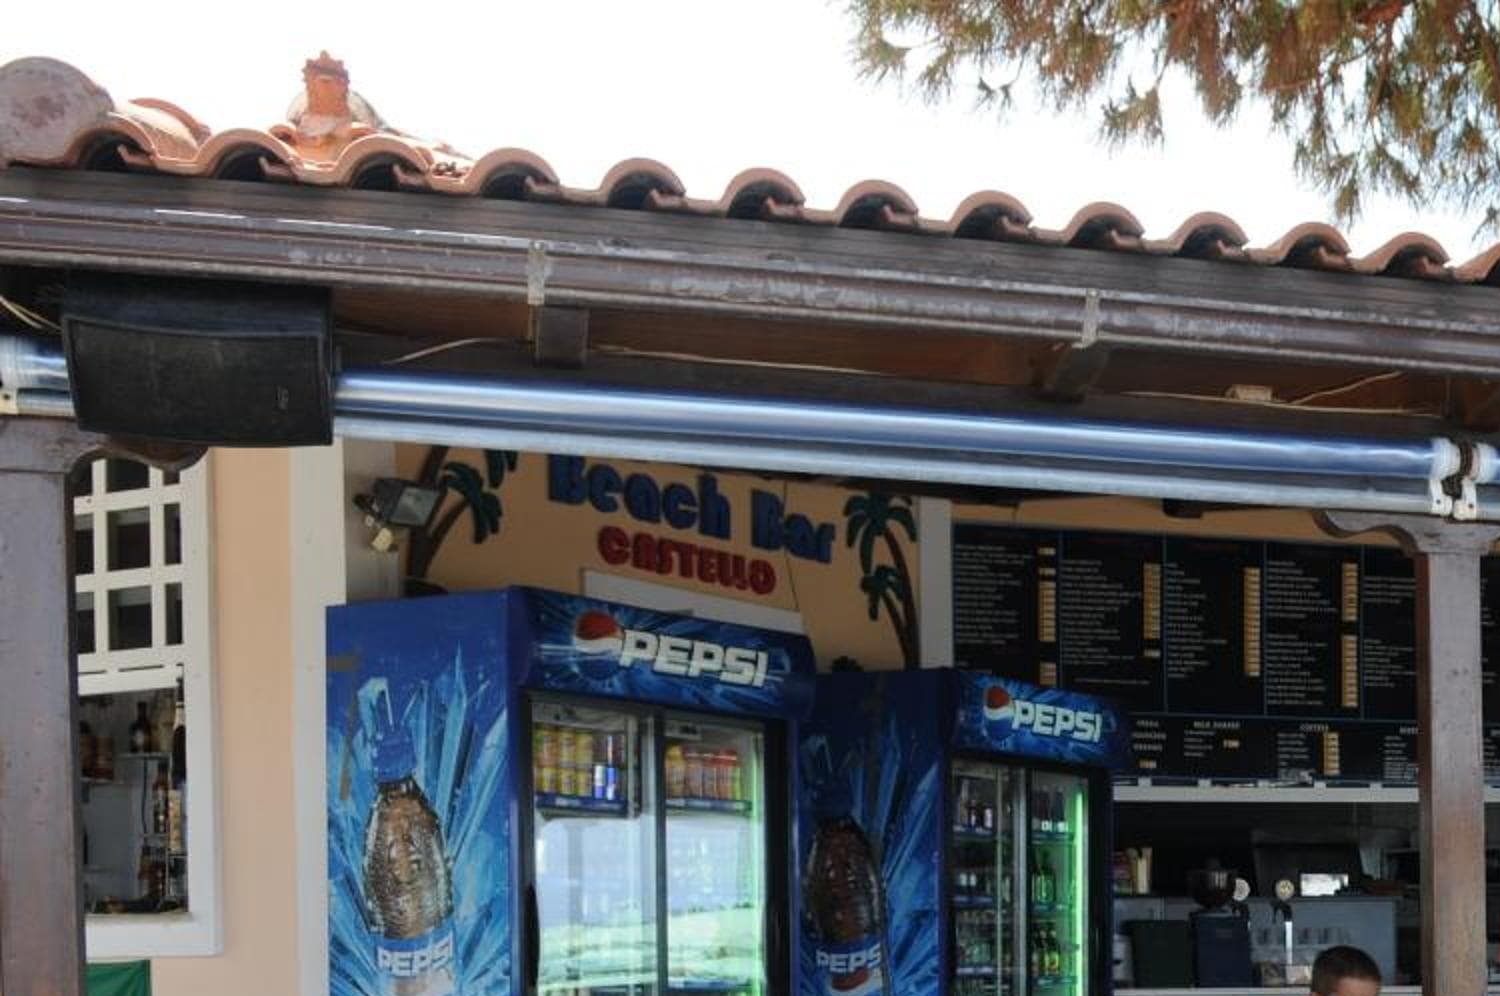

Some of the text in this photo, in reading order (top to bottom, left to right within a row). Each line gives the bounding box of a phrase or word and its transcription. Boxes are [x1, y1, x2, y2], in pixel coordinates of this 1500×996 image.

[547, 453, 836, 565] Beach Bar
[596, 524, 777, 596] CASTELLO
[618, 628, 769, 688] PEPSI
[1011, 699, 1103, 743] PEPSI
